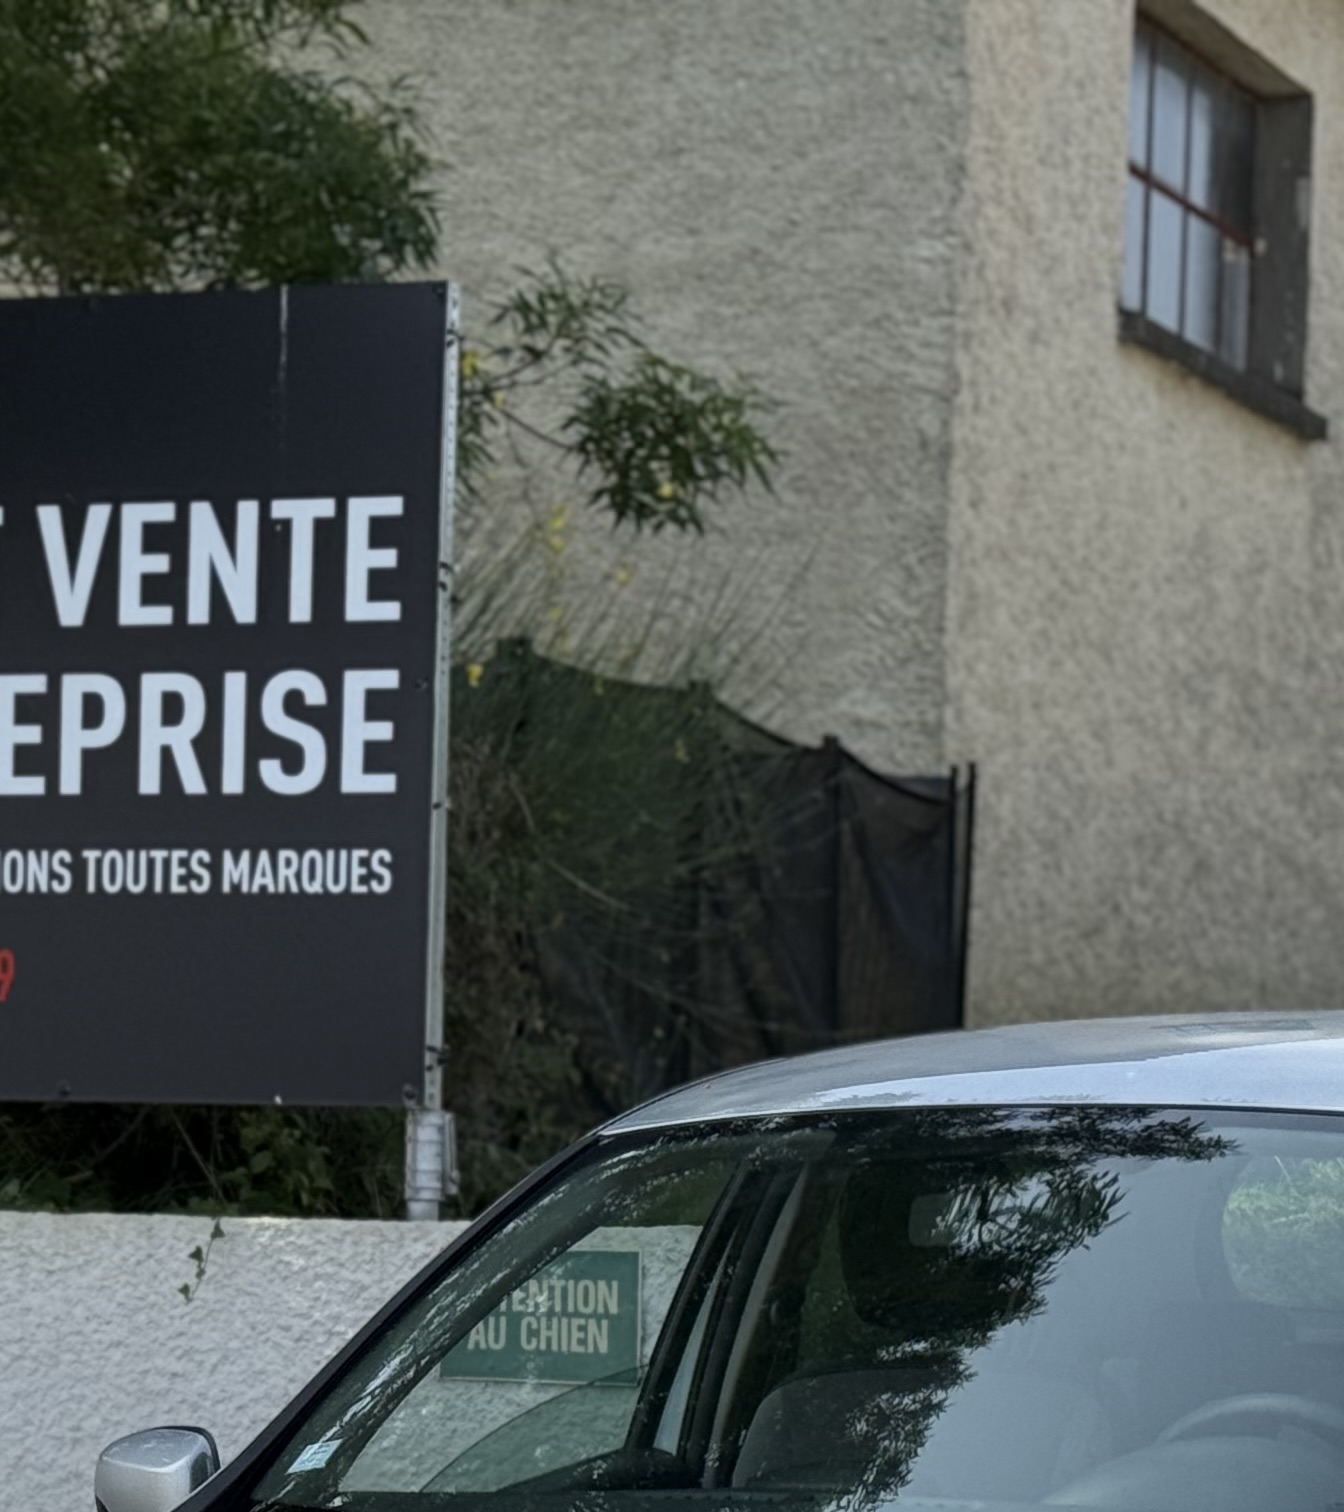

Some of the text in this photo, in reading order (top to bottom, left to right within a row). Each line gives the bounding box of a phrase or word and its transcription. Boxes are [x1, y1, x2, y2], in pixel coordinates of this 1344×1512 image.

[36, 495, 404, 627] VENTE
[82, 849, 211, 894] TOUTES
[222, 849, 392, 894] MARQUES
[500, 1279, 620, 1315] ENTION
[466, 1315, 609, 1354] AU CHIEN
